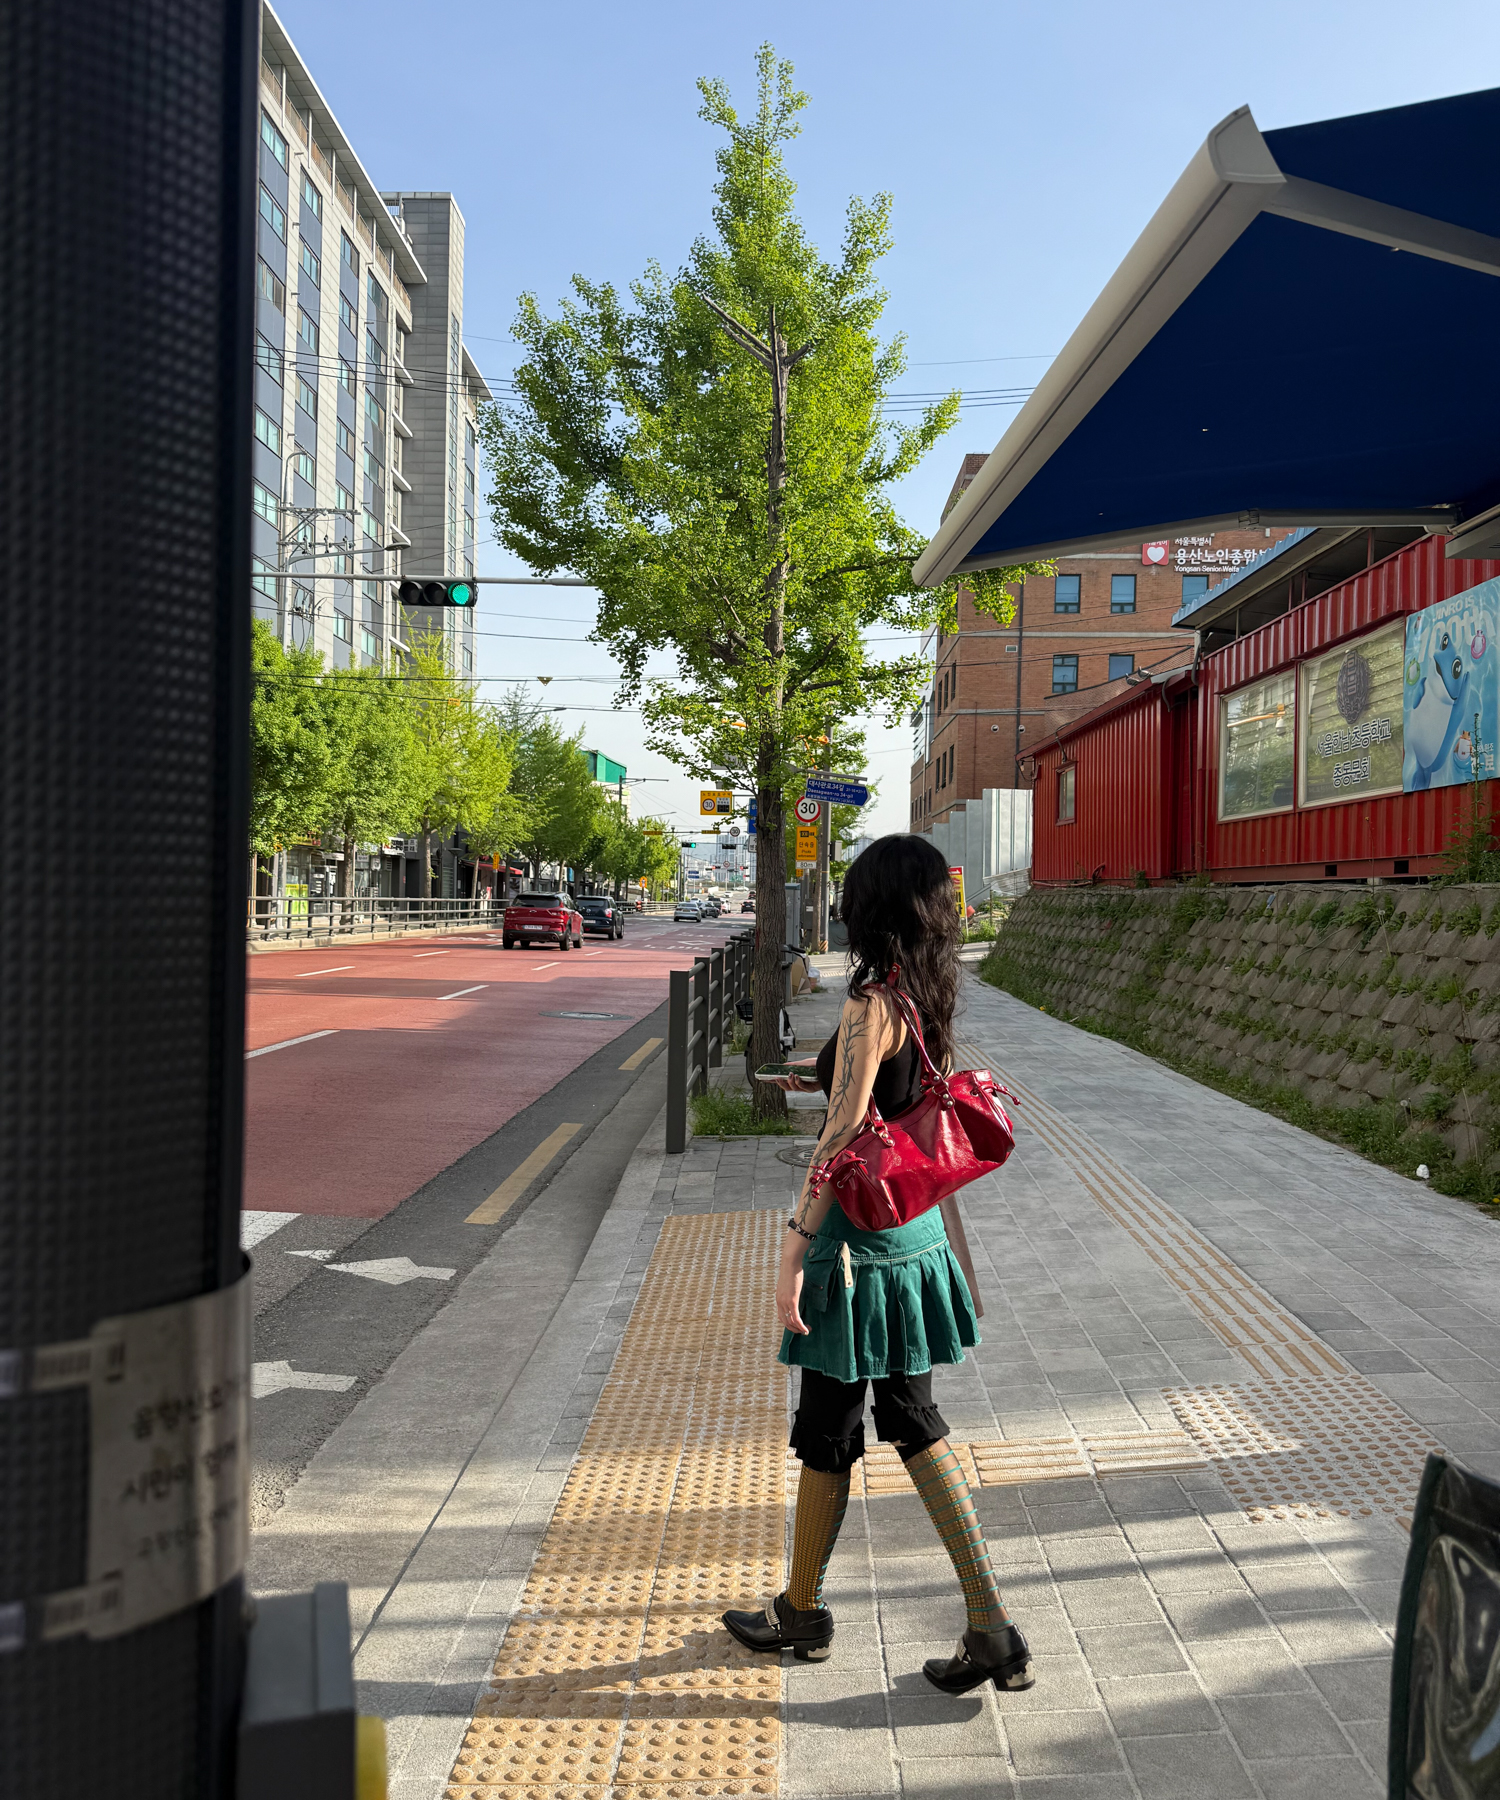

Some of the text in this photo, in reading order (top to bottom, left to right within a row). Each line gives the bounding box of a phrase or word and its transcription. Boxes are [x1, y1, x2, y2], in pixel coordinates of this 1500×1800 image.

[1174, 565, 1201, 573] Yongsan
[1432, 594, 1475, 622] JINRO IS
[1315, 717, 1392, 758] 서울한남초등학교
[1333, 756, 1371, 788] 총동문회
[800, 802, 816, 814] 30
